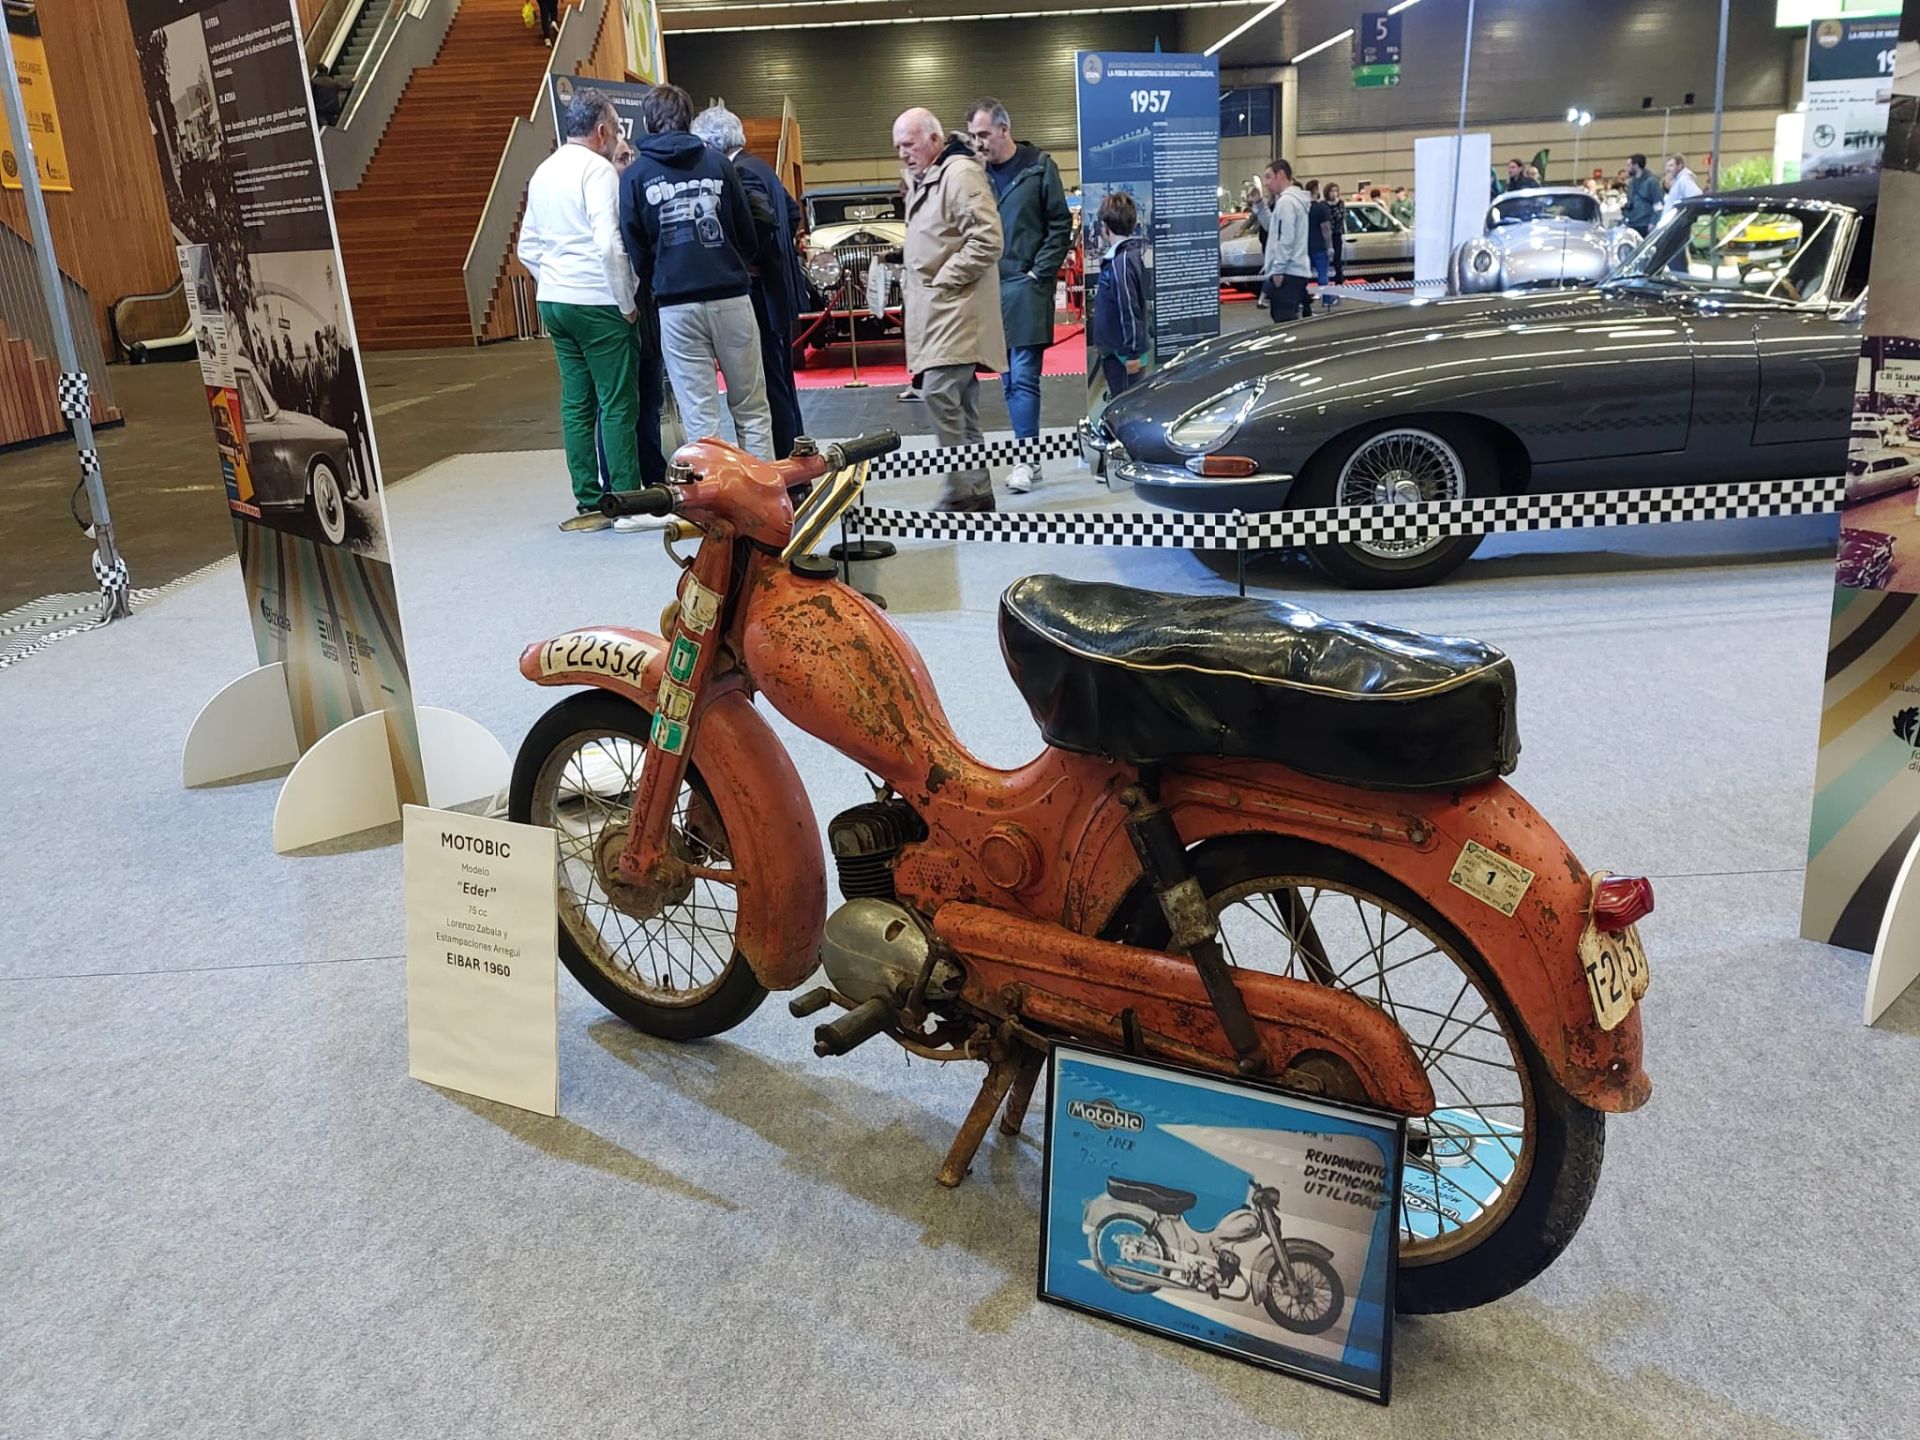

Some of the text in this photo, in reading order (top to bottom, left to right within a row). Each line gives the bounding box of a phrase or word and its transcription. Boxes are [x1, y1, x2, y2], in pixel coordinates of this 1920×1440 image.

[1375, 17, 1389, 41] 5
[1130, 89, 1172, 113] 1957
[645, 178, 724, 206] Chaser
[677, 651, 685, 667] 1
[441, 832, 511, 858] MOTOBIC
[461, 863, 490, 876] Modelo
[1486, 871, 1497, 886] 1
[468, 905, 488, 918] 75 cc
[446, 918, 508, 940] Lorenzo Zabala y
[436, 932, 492, 952] Estampaciones
[446, 952, 511, 977] EIBAR 1960
[1304, 1148, 1388, 1178] RENDIMIENTO
